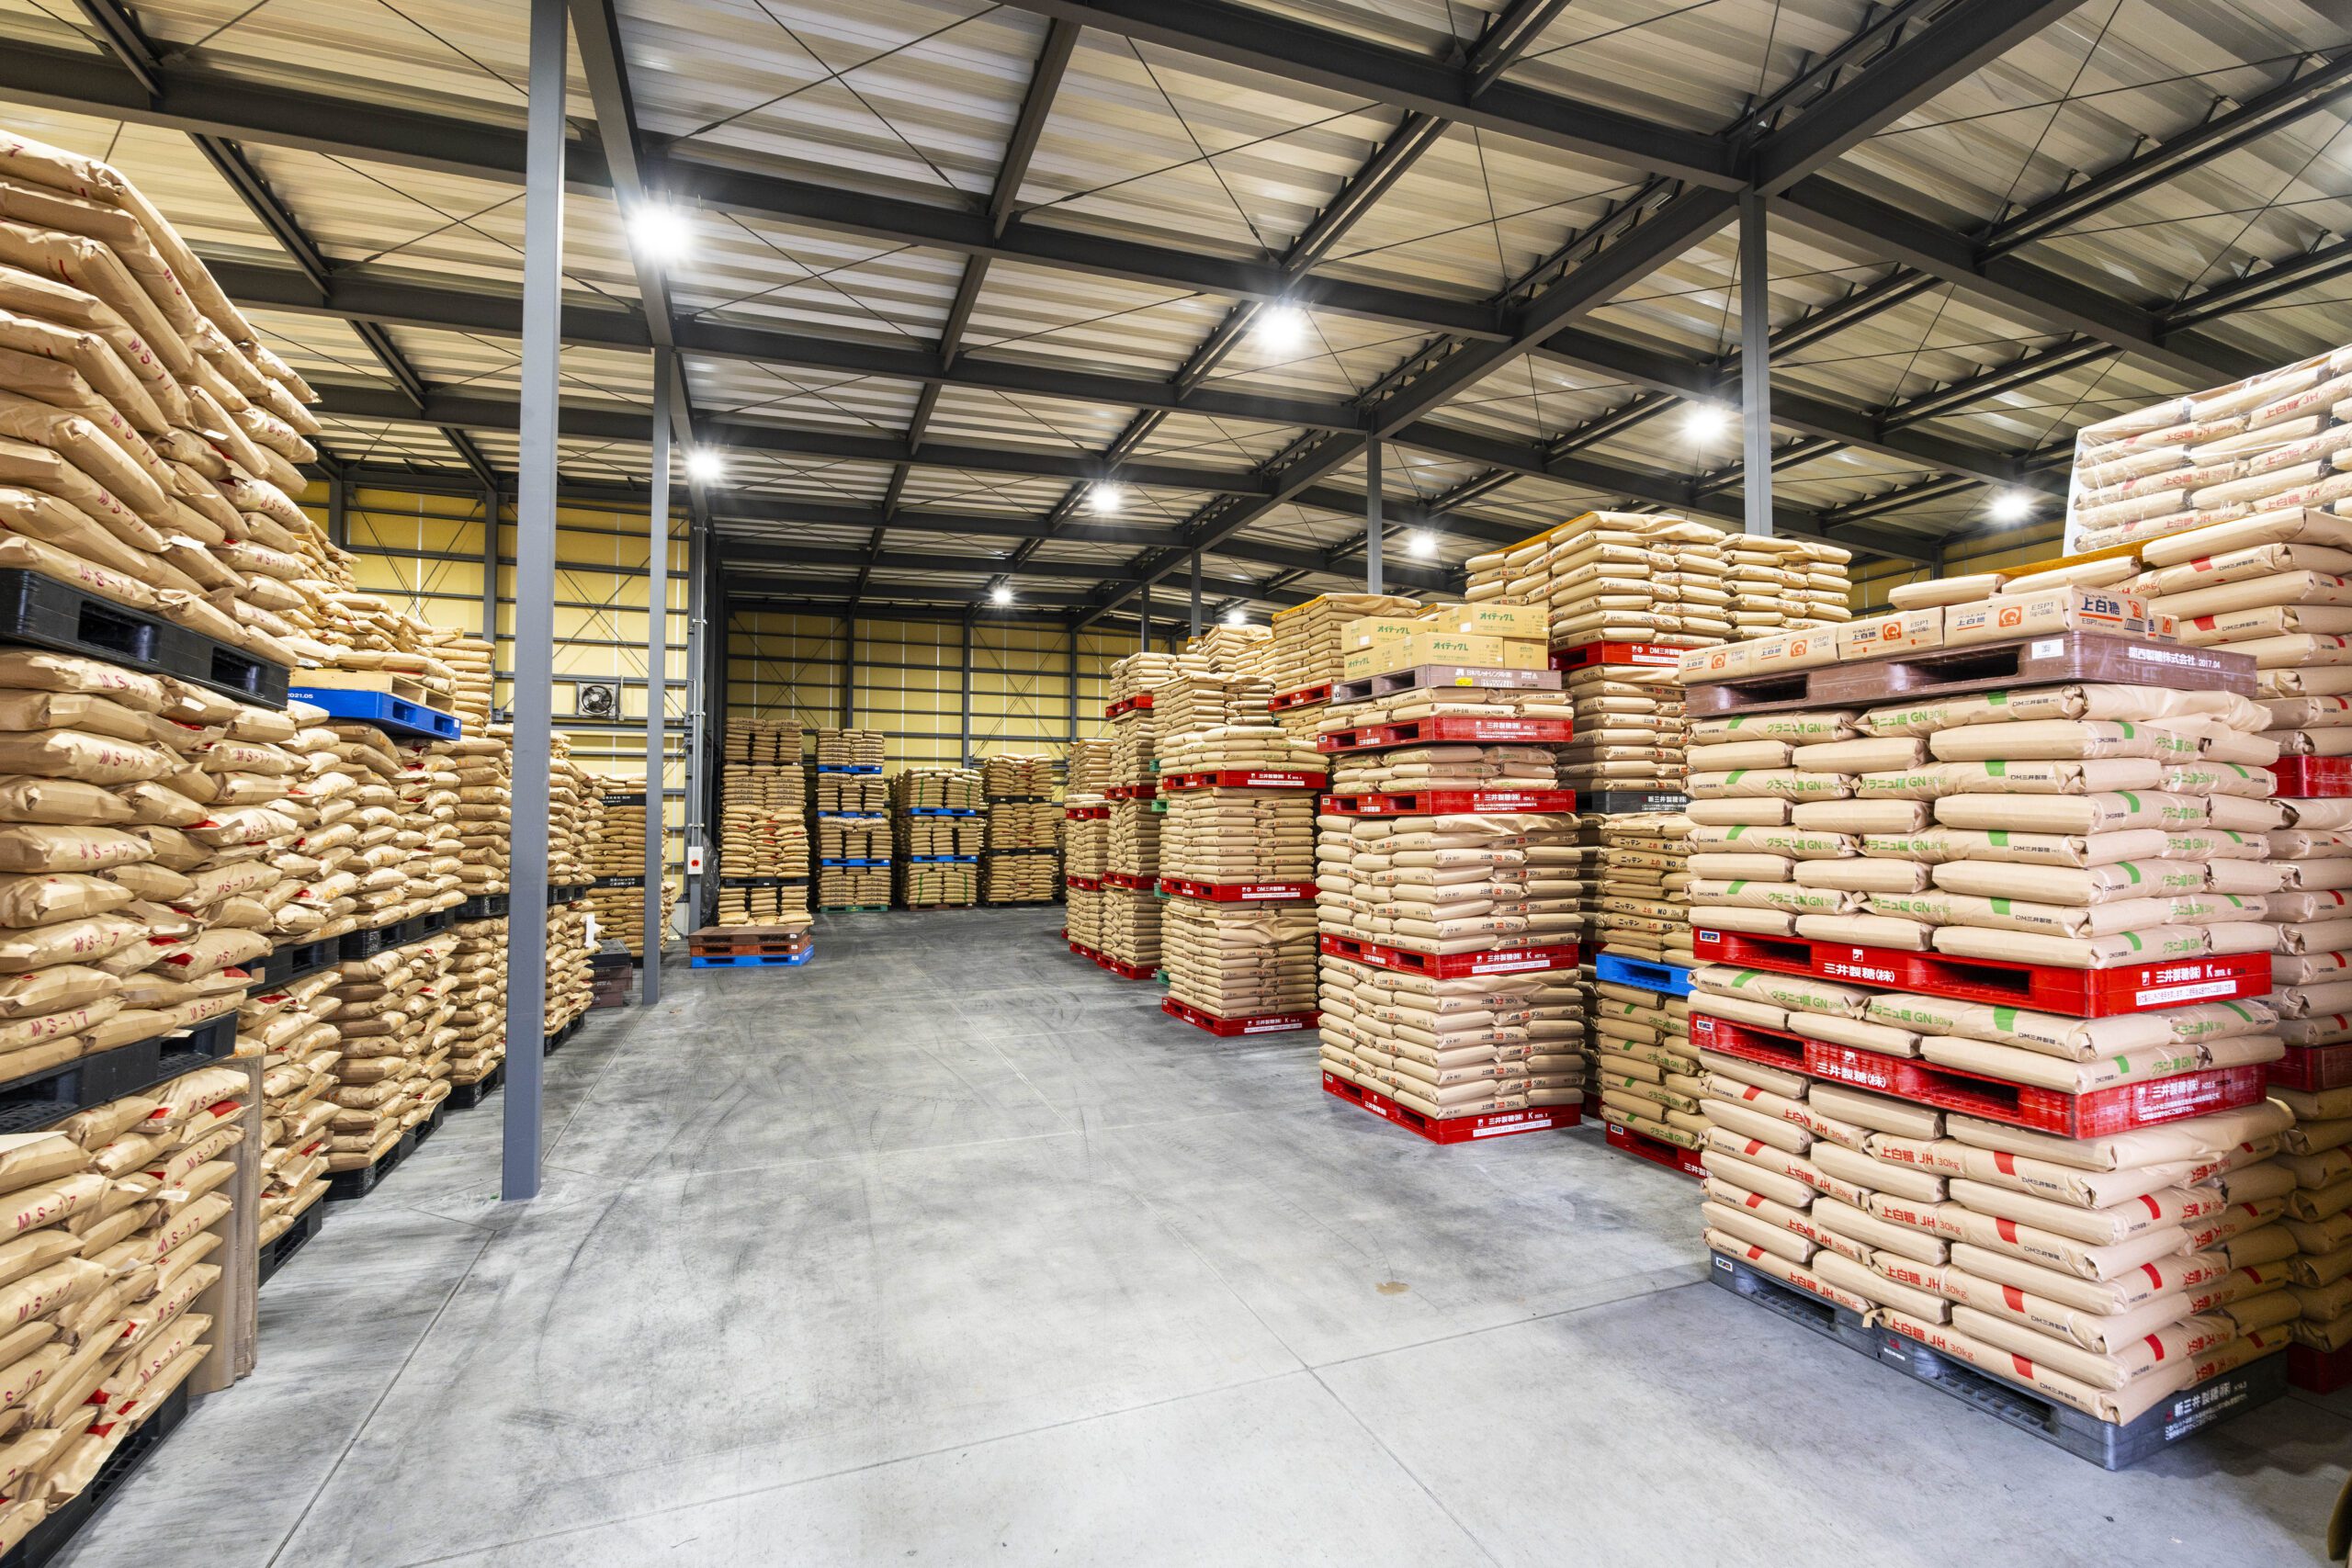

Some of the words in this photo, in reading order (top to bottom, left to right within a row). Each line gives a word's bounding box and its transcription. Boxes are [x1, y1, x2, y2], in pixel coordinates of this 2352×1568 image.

[2081, 596, 2120, 615] 上白糖
[1479, 612, 1515, 623] オイテックL
[1376, 625, 1410, 636] オイテックL
[1852, 631, 1876, 640] 上白糖
[1432, 642, 1469, 651] オイテックL
[1910, 711, 1928, 723] GN
[1806, 723, 1820, 732] GN
[1806, 781, 1820, 791] GN
[1908, 776, 1926, 787] GN
[1620, 838, 1641, 846] ニッテン
[1807, 840, 1822, 851] GN
[1911, 840, 1928, 851] GN
[1621, 856, 1643, 864] ニッテン
[1614, 901, 1635, 910] ニッテン
[1808, 897, 1824, 906] GN
[1913, 902, 1930, 912] GN
[1618, 919, 1639, 927] ニッテン
[1824, 963, 1895, 983] 三井製糖(株)
[2155, 966, 2201, 984] 三井製糖(株)
[2206, 964, 2213, 978] K
[1813, 997, 1827, 1009] GN
[29, 1010, 89, 1038] MS-17
[1914, 1011, 1932, 1024] GN
[1815, 1061, 1887, 1089] 三井製糖(株)
[2152, 1078, 2199, 1099] 三井製糖(株)
[1815, 1122, 1828, 1134] JH
[1831, 1131, 1851, 1144] 30kg
[1881, 1146, 1914, 1163] 上白糖
[1918, 1153, 1934, 1166] JH
[1938, 1157, 1961, 1170] 30kg
[1818, 1179, 1830, 1191] JH
[1834, 1187, 1853, 1201] 30kg
[17, 1195, 78, 1232] MS-17
[1882, 1205, 1917, 1224] 上白糖
[1920, 1215, 1936, 1227] JH
[1939, 1221, 1962, 1235] 30kg
[157, 1216, 201, 1255] MS-17
[1819, 1234, 1832, 1247] JH
[1836, 1242, 1855, 1256] 30kg
[1788, 1271, 1816, 1292] 上白糖
[1820, 1287, 1834, 1299] JH
[1837, 1294, 1858, 1309] 30kg
[1886, 1266, 1921, 1285] 上白糖
[1926, 1278, 1940, 1290] JH
[1944, 1284, 1968, 1299] 30kg
[1891, 1318, 1926, 1342] 上白糖
[1929, 1335, 1946, 1349] JH
[1951, 1344, 1974, 1361] 30kg
[140, 1339, 183, 1386] MS-17
[2040, 1382, 2077, 1403] DM三井製糖
